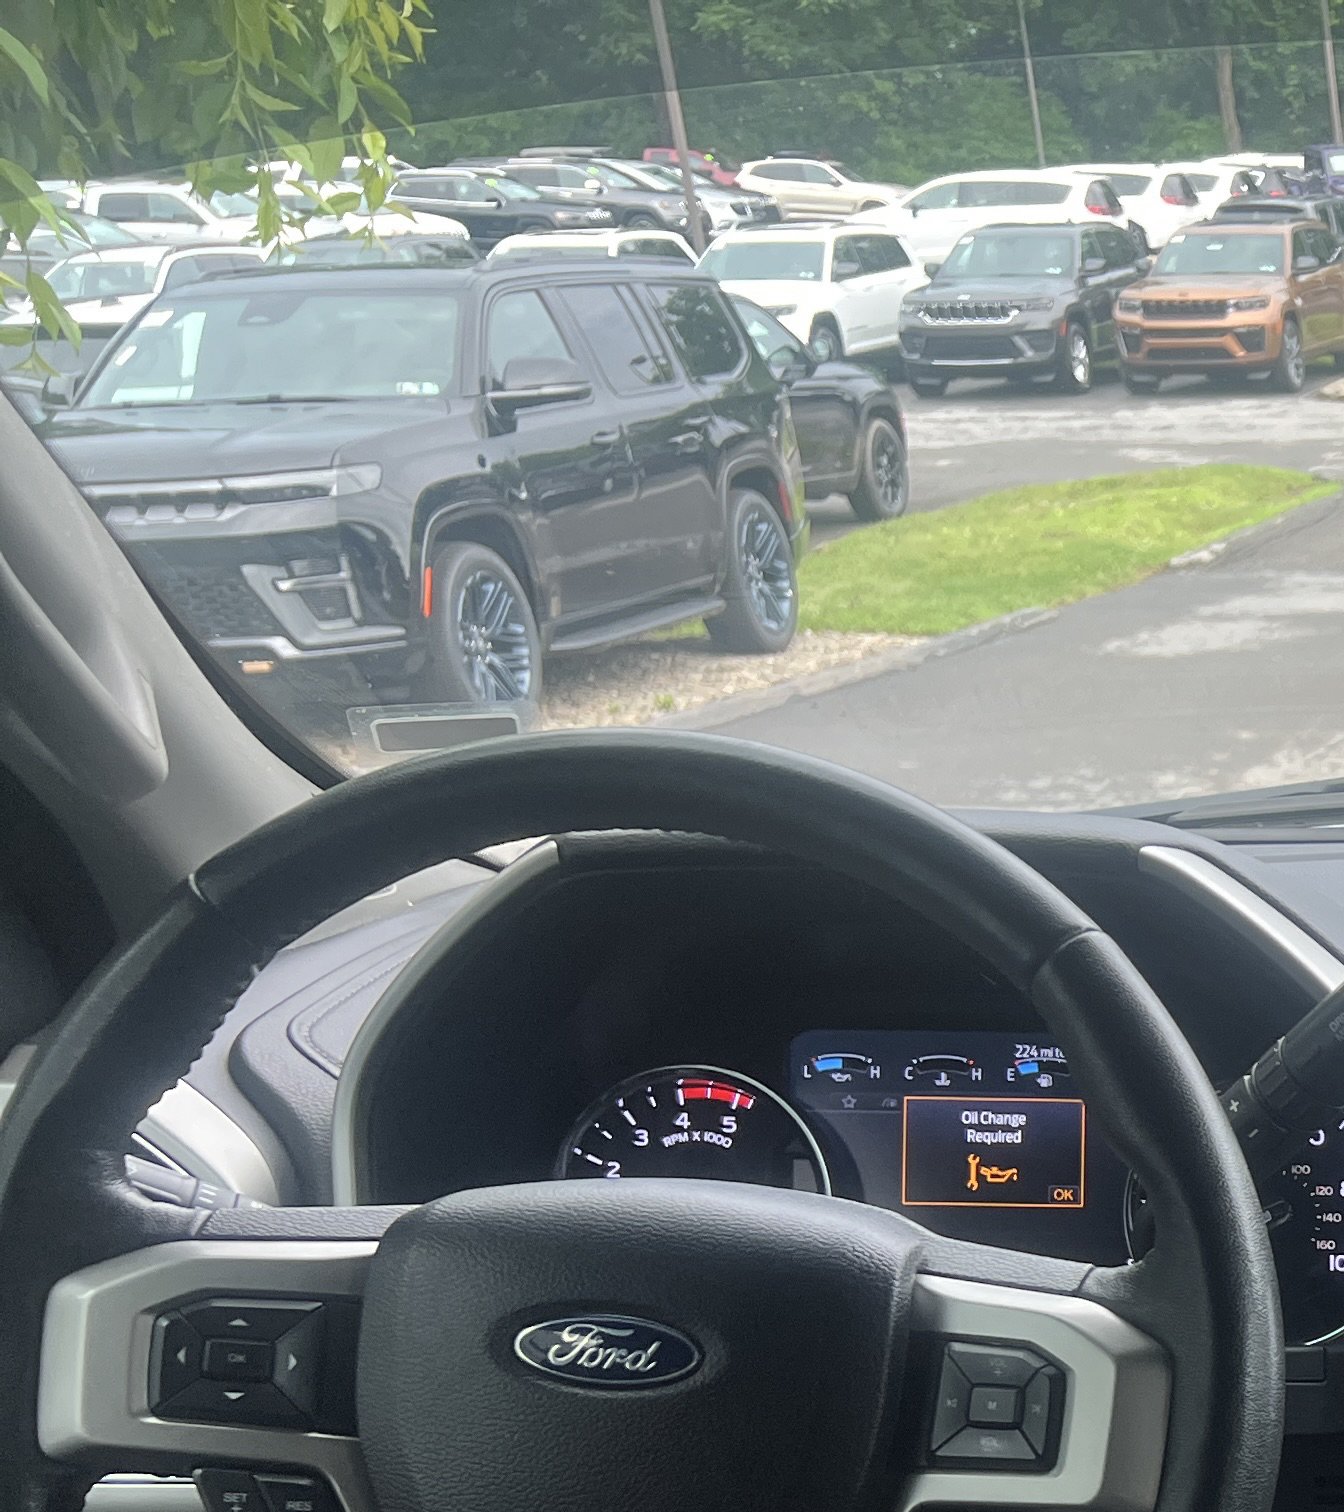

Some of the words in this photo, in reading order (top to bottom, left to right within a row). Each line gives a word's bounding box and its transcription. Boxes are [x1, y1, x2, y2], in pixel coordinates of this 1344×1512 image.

[1014, 1043, 1039, 1058] 224
[1040, 1046, 1054, 1058] mi
[802, 1064, 811, 1079] L
[869, 1065, 881, 1080] H
[904, 1066, 914, 1081] C
[971, 1067, 982, 1081] H
[1006, 1068, 1016, 1082] E
[674, 1112, 691, 1130] 4
[720, 1115, 738, 1134] 5
[961, 1110, 979, 1126] Oil
[981, 1110, 1027, 1128] Change
[632, 1129, 649, 1147] 3
[660, 1131, 690, 1149] RPM
[703, 1131, 734, 1149] 1000
[966, 1129, 1022, 1146] Required
[606, 1161, 621, 1178] 2
[1291, 1164, 1311, 1175] 100
[1053, 1188, 1074, 1201] OK
[1315, 1185, 1334, 1196] 120
[1322, 1212, 1342, 1223] 140
[1316, 1239, 1336, 1250] 160
[548, 1323, 663, 1373] Ford
[223, 1492, 248, 1503] SET
[285, 1500, 314, 1512] RES
